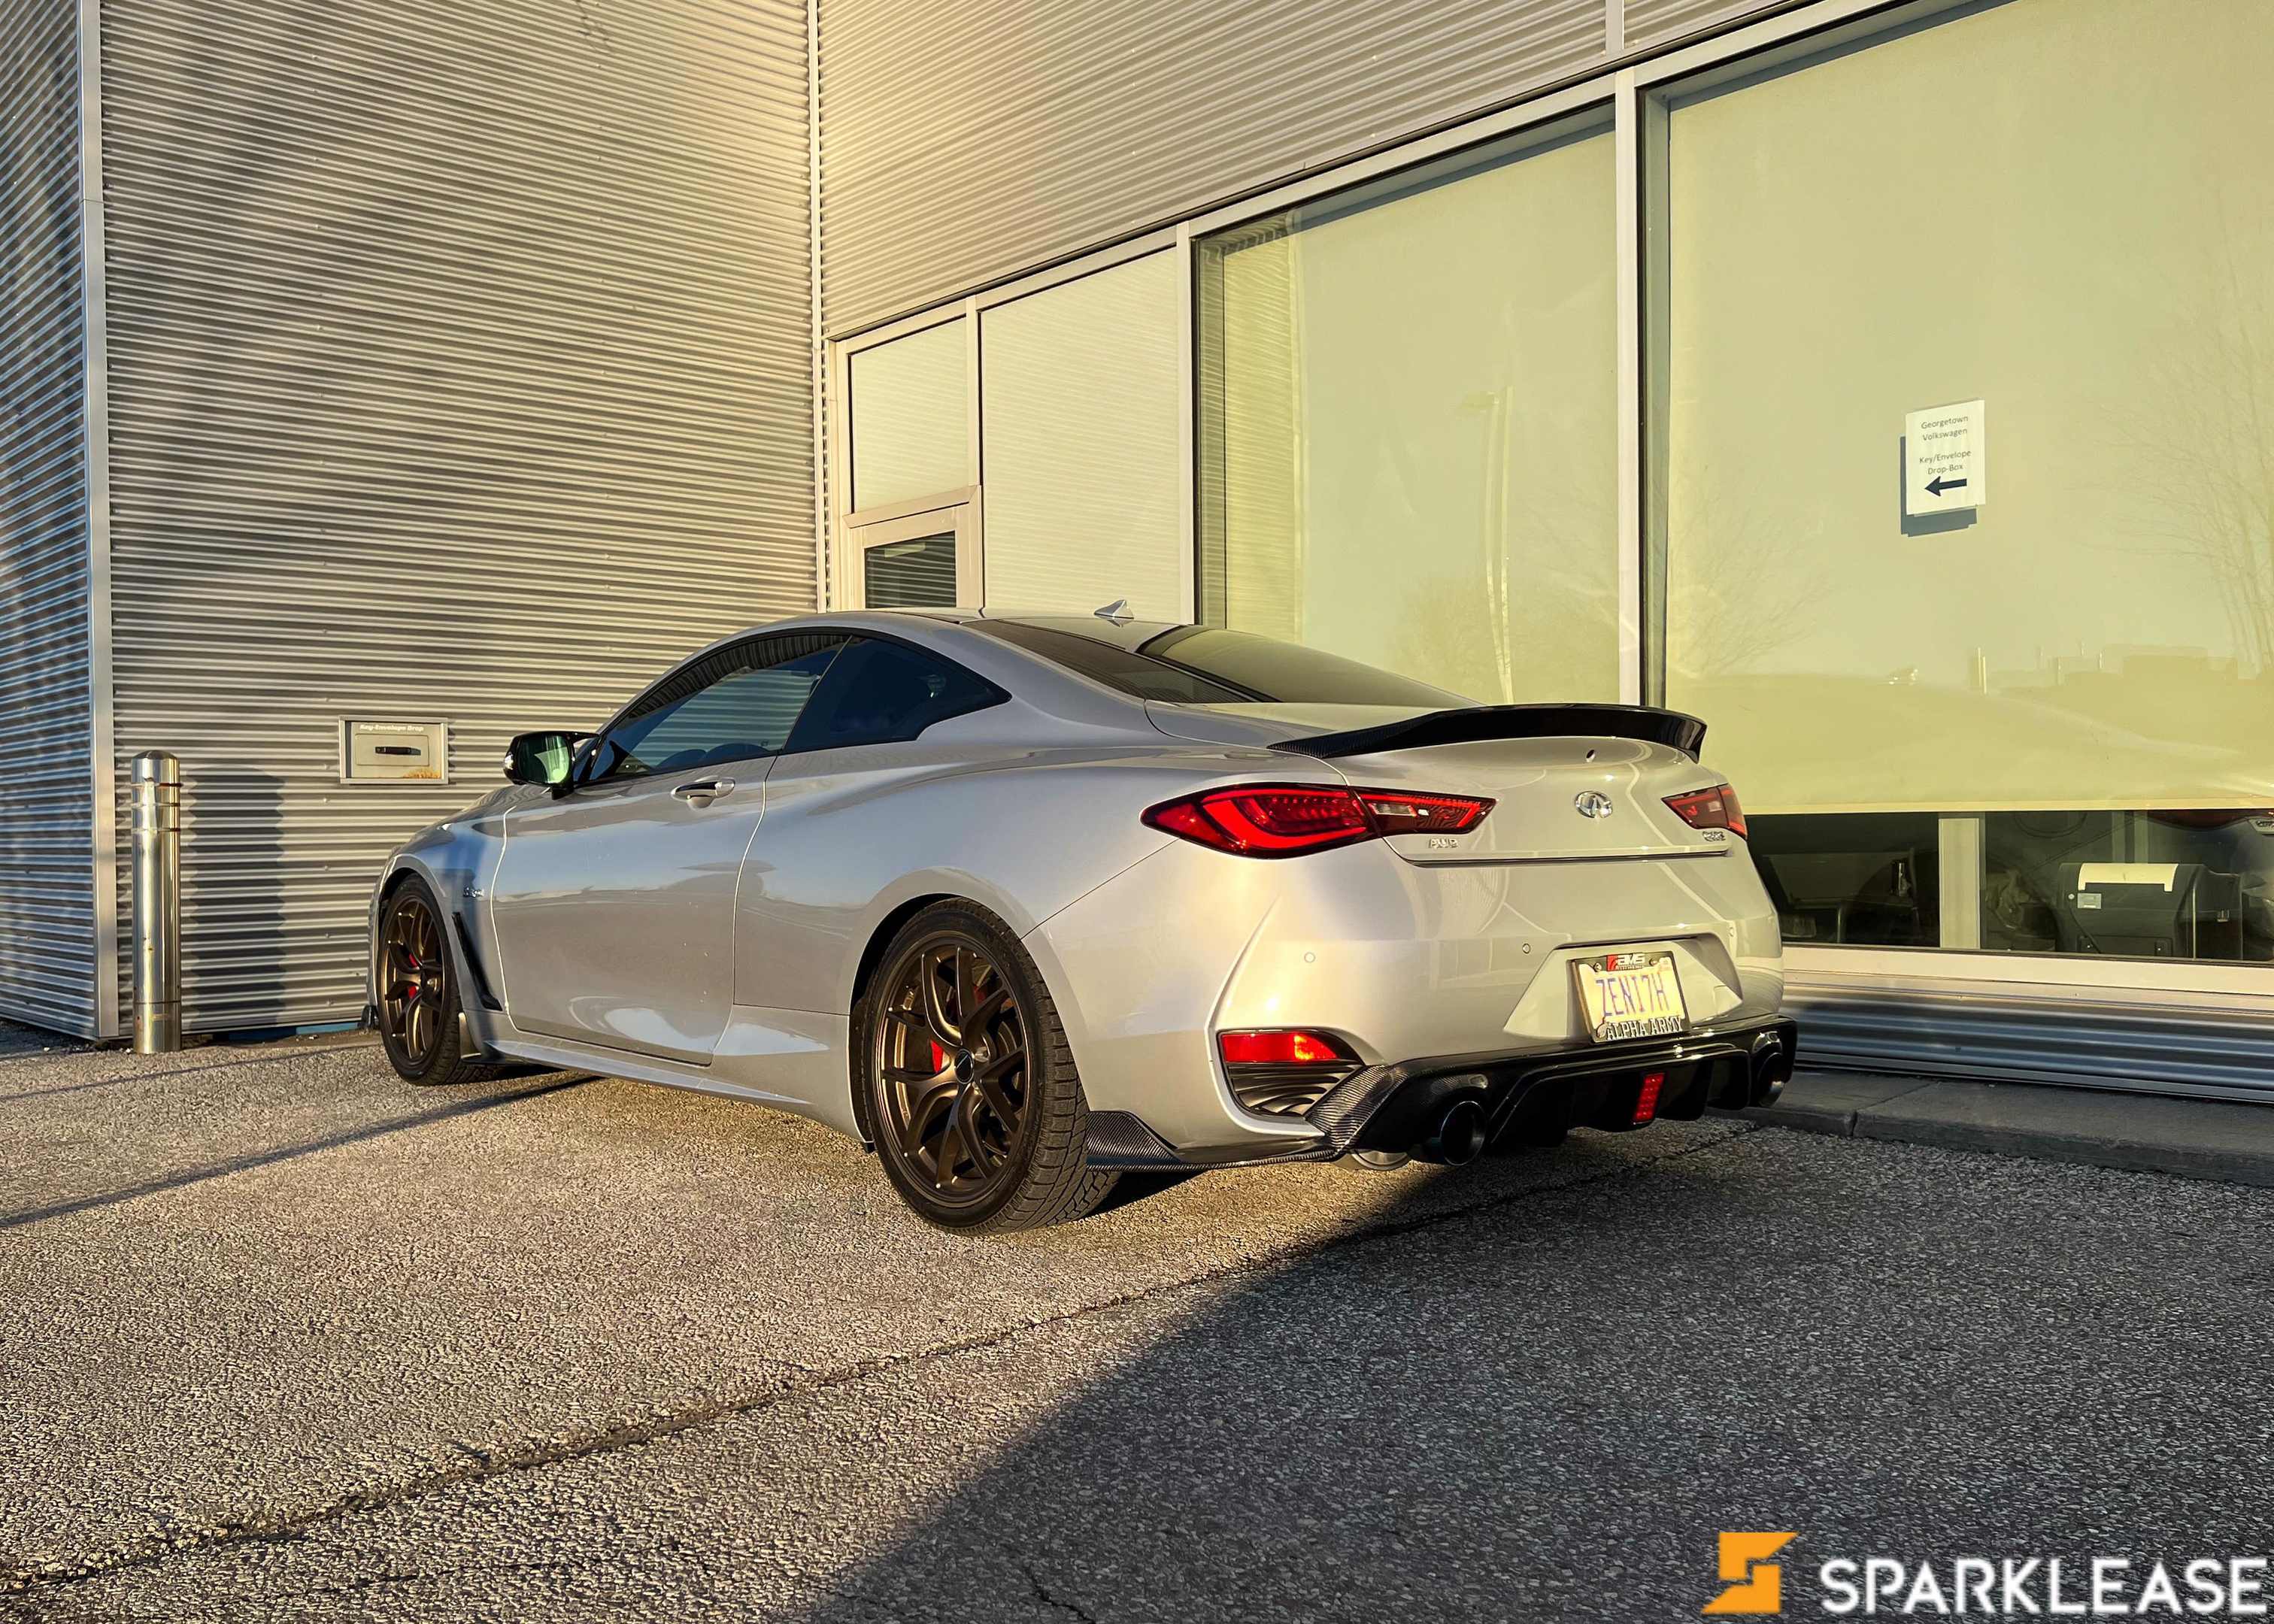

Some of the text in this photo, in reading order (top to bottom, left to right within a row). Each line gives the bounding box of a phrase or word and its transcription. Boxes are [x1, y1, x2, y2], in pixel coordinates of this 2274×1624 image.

[1921, 416, 1969, 429] Georgetown
[1922, 429, 1967, 441] Volkswagen
[1919, 450, 1972, 464] Key/Envelope
[1927, 464, 1963, 474] Drop-Box
[1606, 1017, 1683, 1041] ALPHA ARMY
